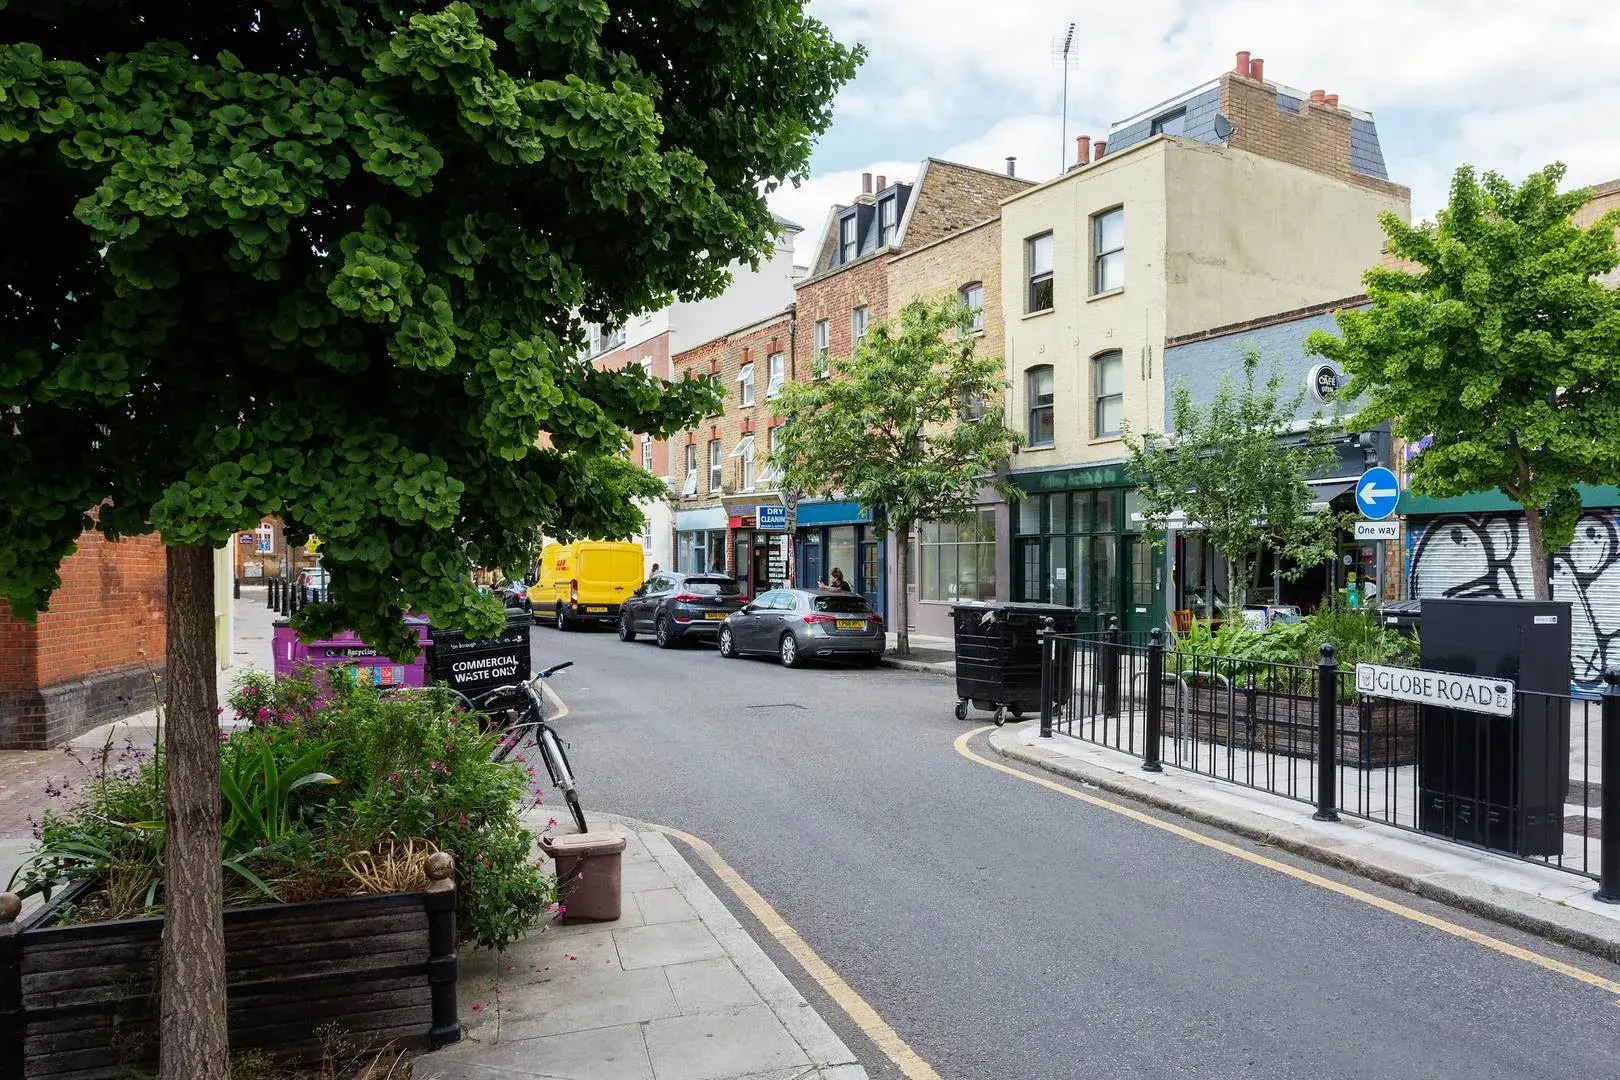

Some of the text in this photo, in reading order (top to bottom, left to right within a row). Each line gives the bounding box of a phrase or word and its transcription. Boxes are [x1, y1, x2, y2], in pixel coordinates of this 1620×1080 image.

[1358, 525, 1397, 536] One way
[458, 641, 477, 649] Borough
[347, 648, 377, 657] Recycling
[452, 655, 517, 672] COMMERCIAL
[455, 666, 517, 683] WASTE ONLY
[1377, 671, 1493, 706] GLOBE ROAD
[1496, 695, 1508, 708] E2
